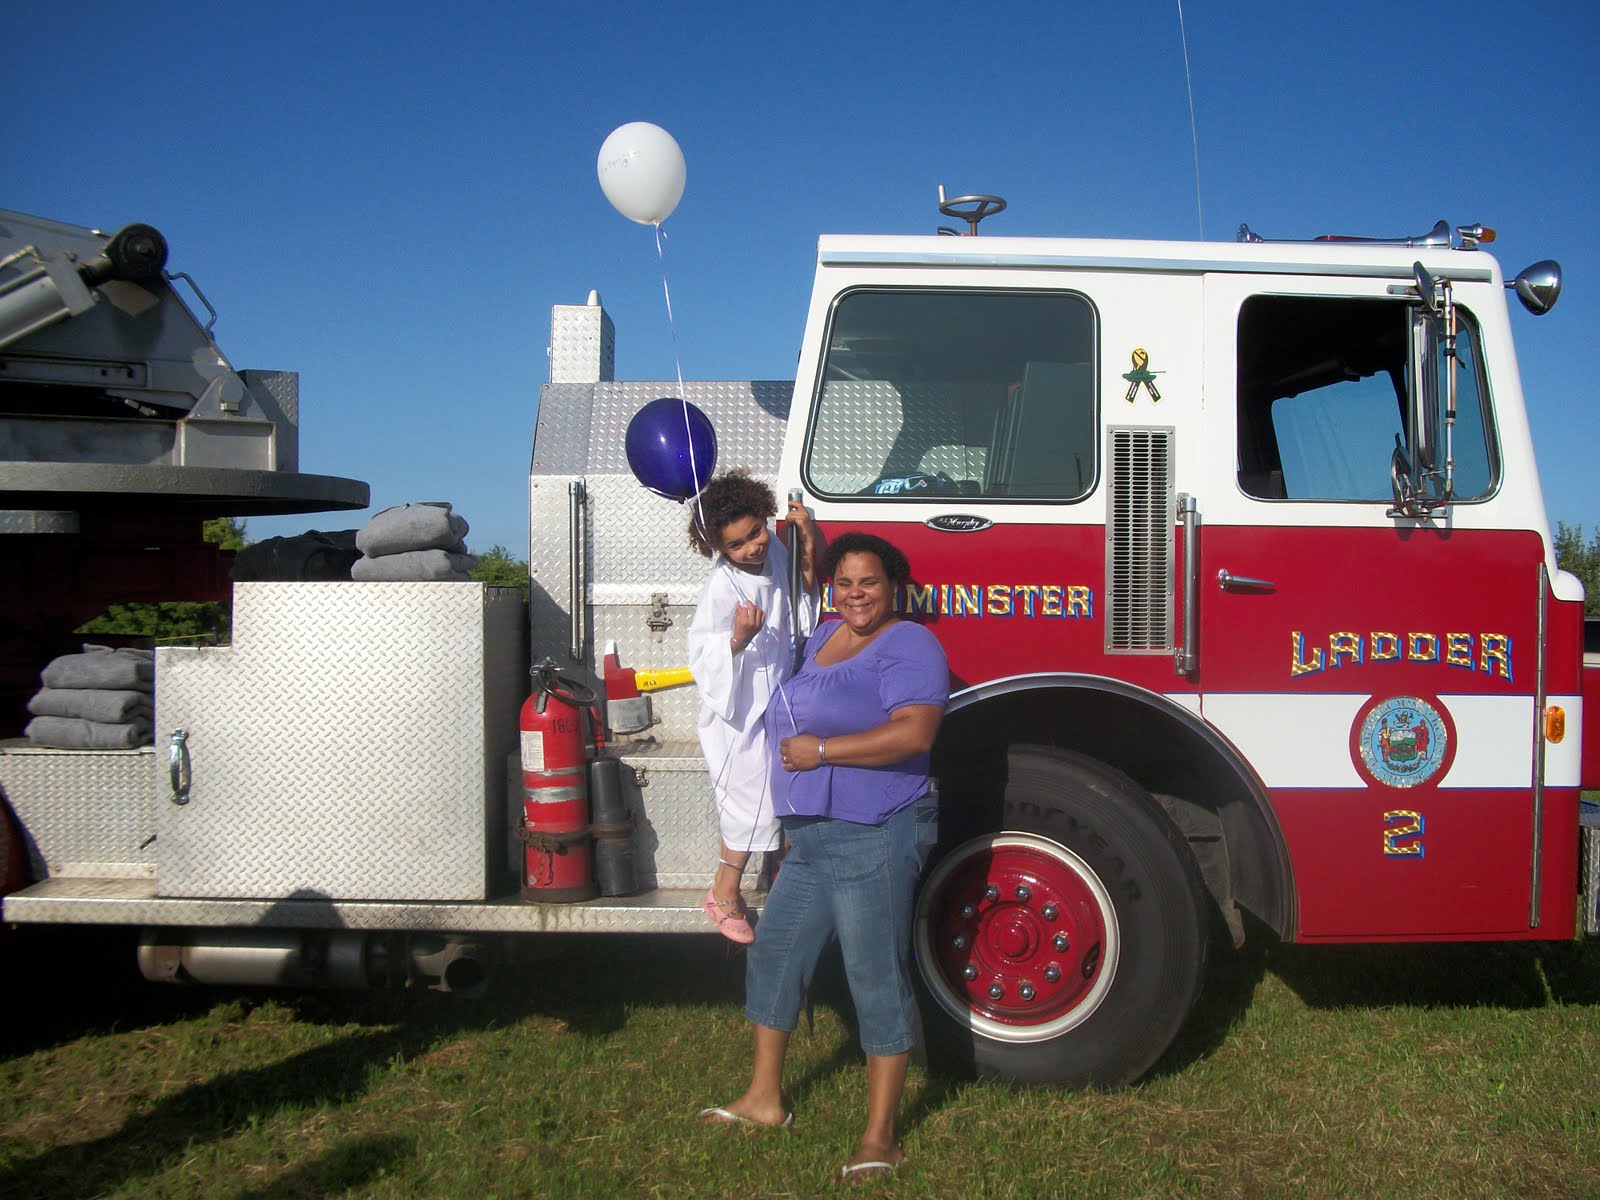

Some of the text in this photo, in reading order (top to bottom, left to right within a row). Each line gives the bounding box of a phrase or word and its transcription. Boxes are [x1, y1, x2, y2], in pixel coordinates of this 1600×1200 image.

[822, 581, 1094, 618] LMINSTER
[1290, 630, 1515, 684] LADDER
[1383, 809, 1425, 859] 2
